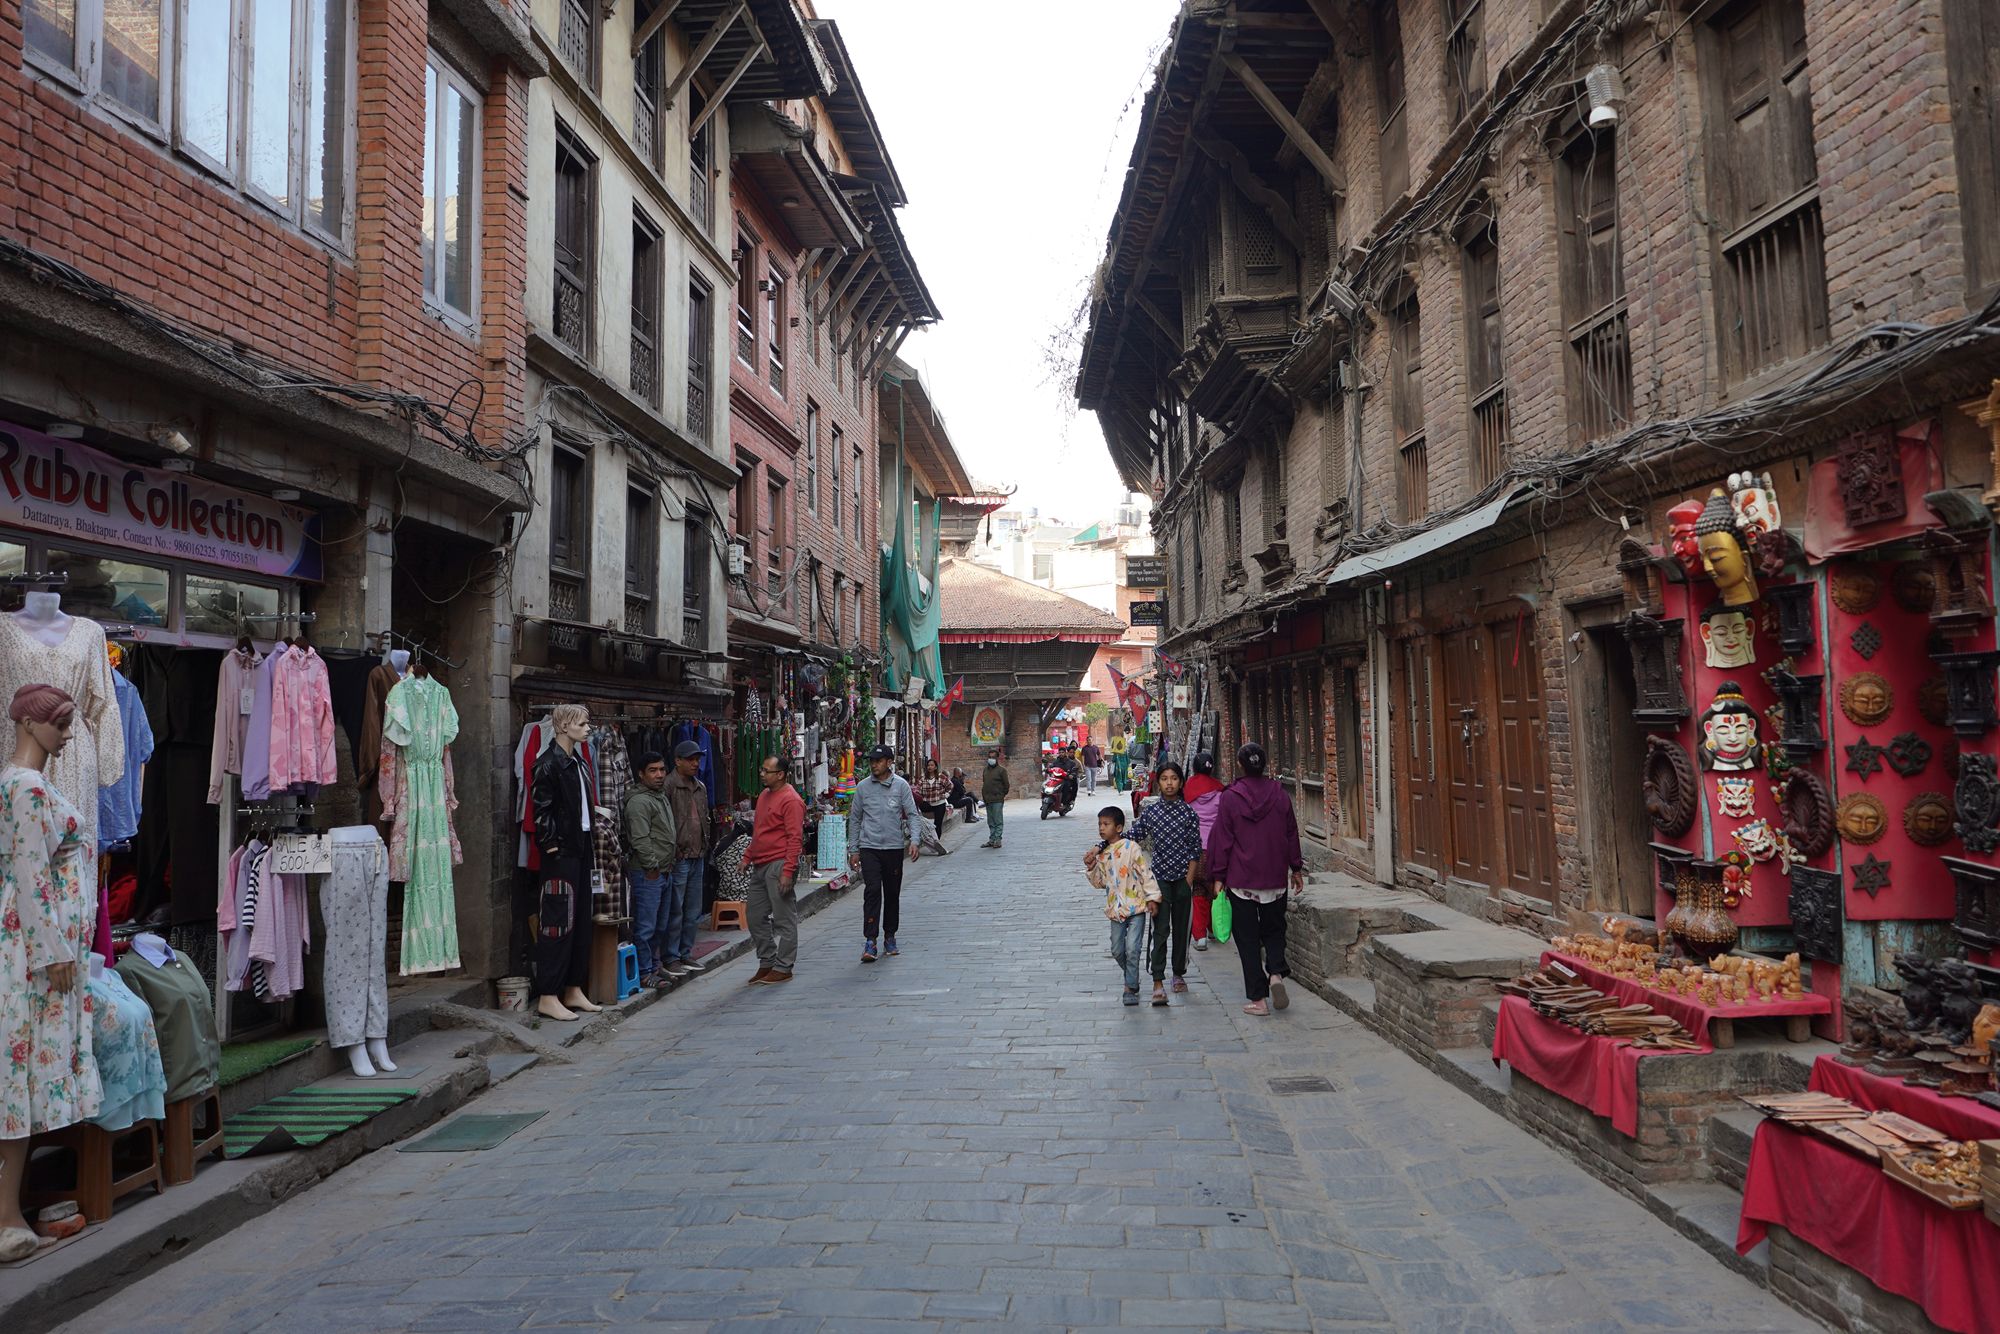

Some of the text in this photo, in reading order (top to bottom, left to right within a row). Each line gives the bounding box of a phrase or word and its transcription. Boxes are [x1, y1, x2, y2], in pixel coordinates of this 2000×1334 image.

[0, 431, 283, 553] Rubu Collection
[123, 528, 152, 546] Contact
[276, 835, 307, 853] SALE
[280, 855, 310, 872] 500/-
